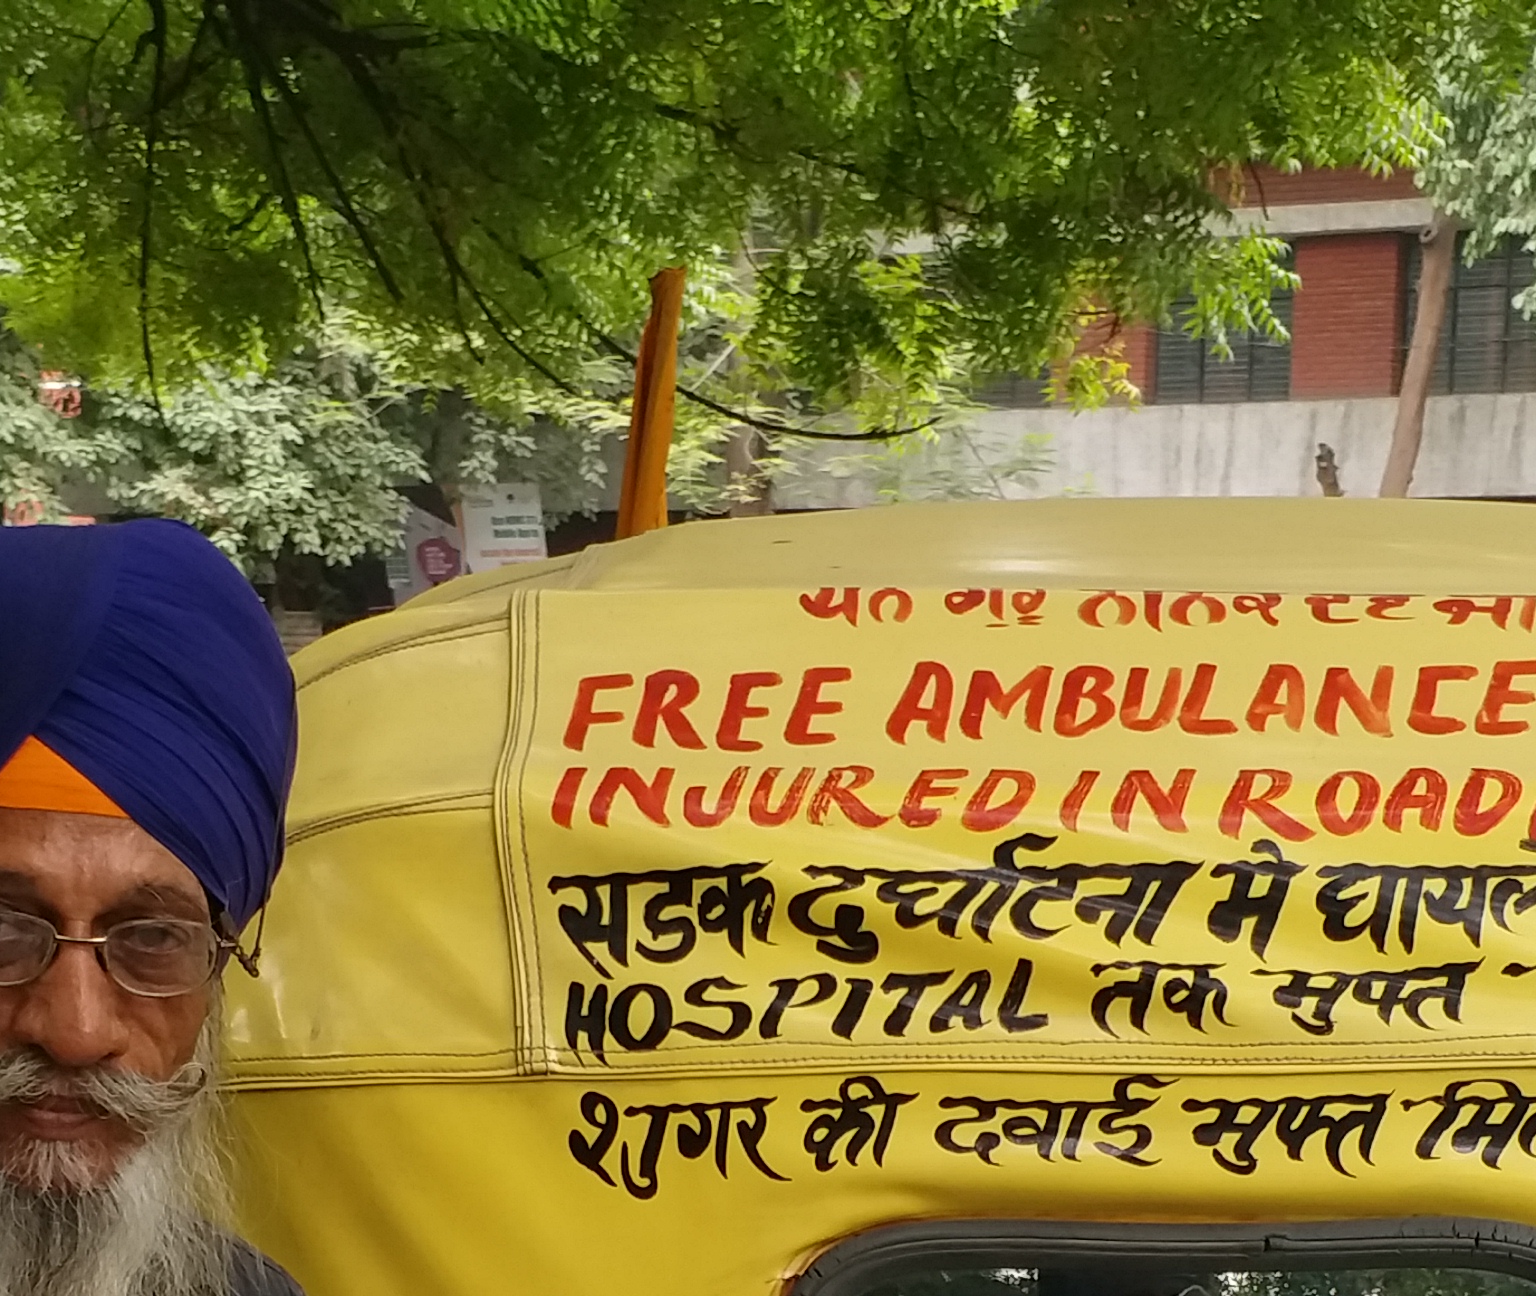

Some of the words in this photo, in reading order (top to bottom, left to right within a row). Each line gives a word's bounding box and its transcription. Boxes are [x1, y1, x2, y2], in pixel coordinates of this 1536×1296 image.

[564, 667, 852, 752] FREE
[550, 765, 1037, 832] INJURED
[1059, 768, 1189, 832] IN
[1217, 767, 1522, 841] ROAD
[565, 958, 1049, 1066] HOSPITAL
[1090, 960, 1234, 1036] तक
[569, 1092, 791, 1199] शुगर
[800, 1076, 918, 1171] की
[935, 1073, 1177, 1166] दवाई
